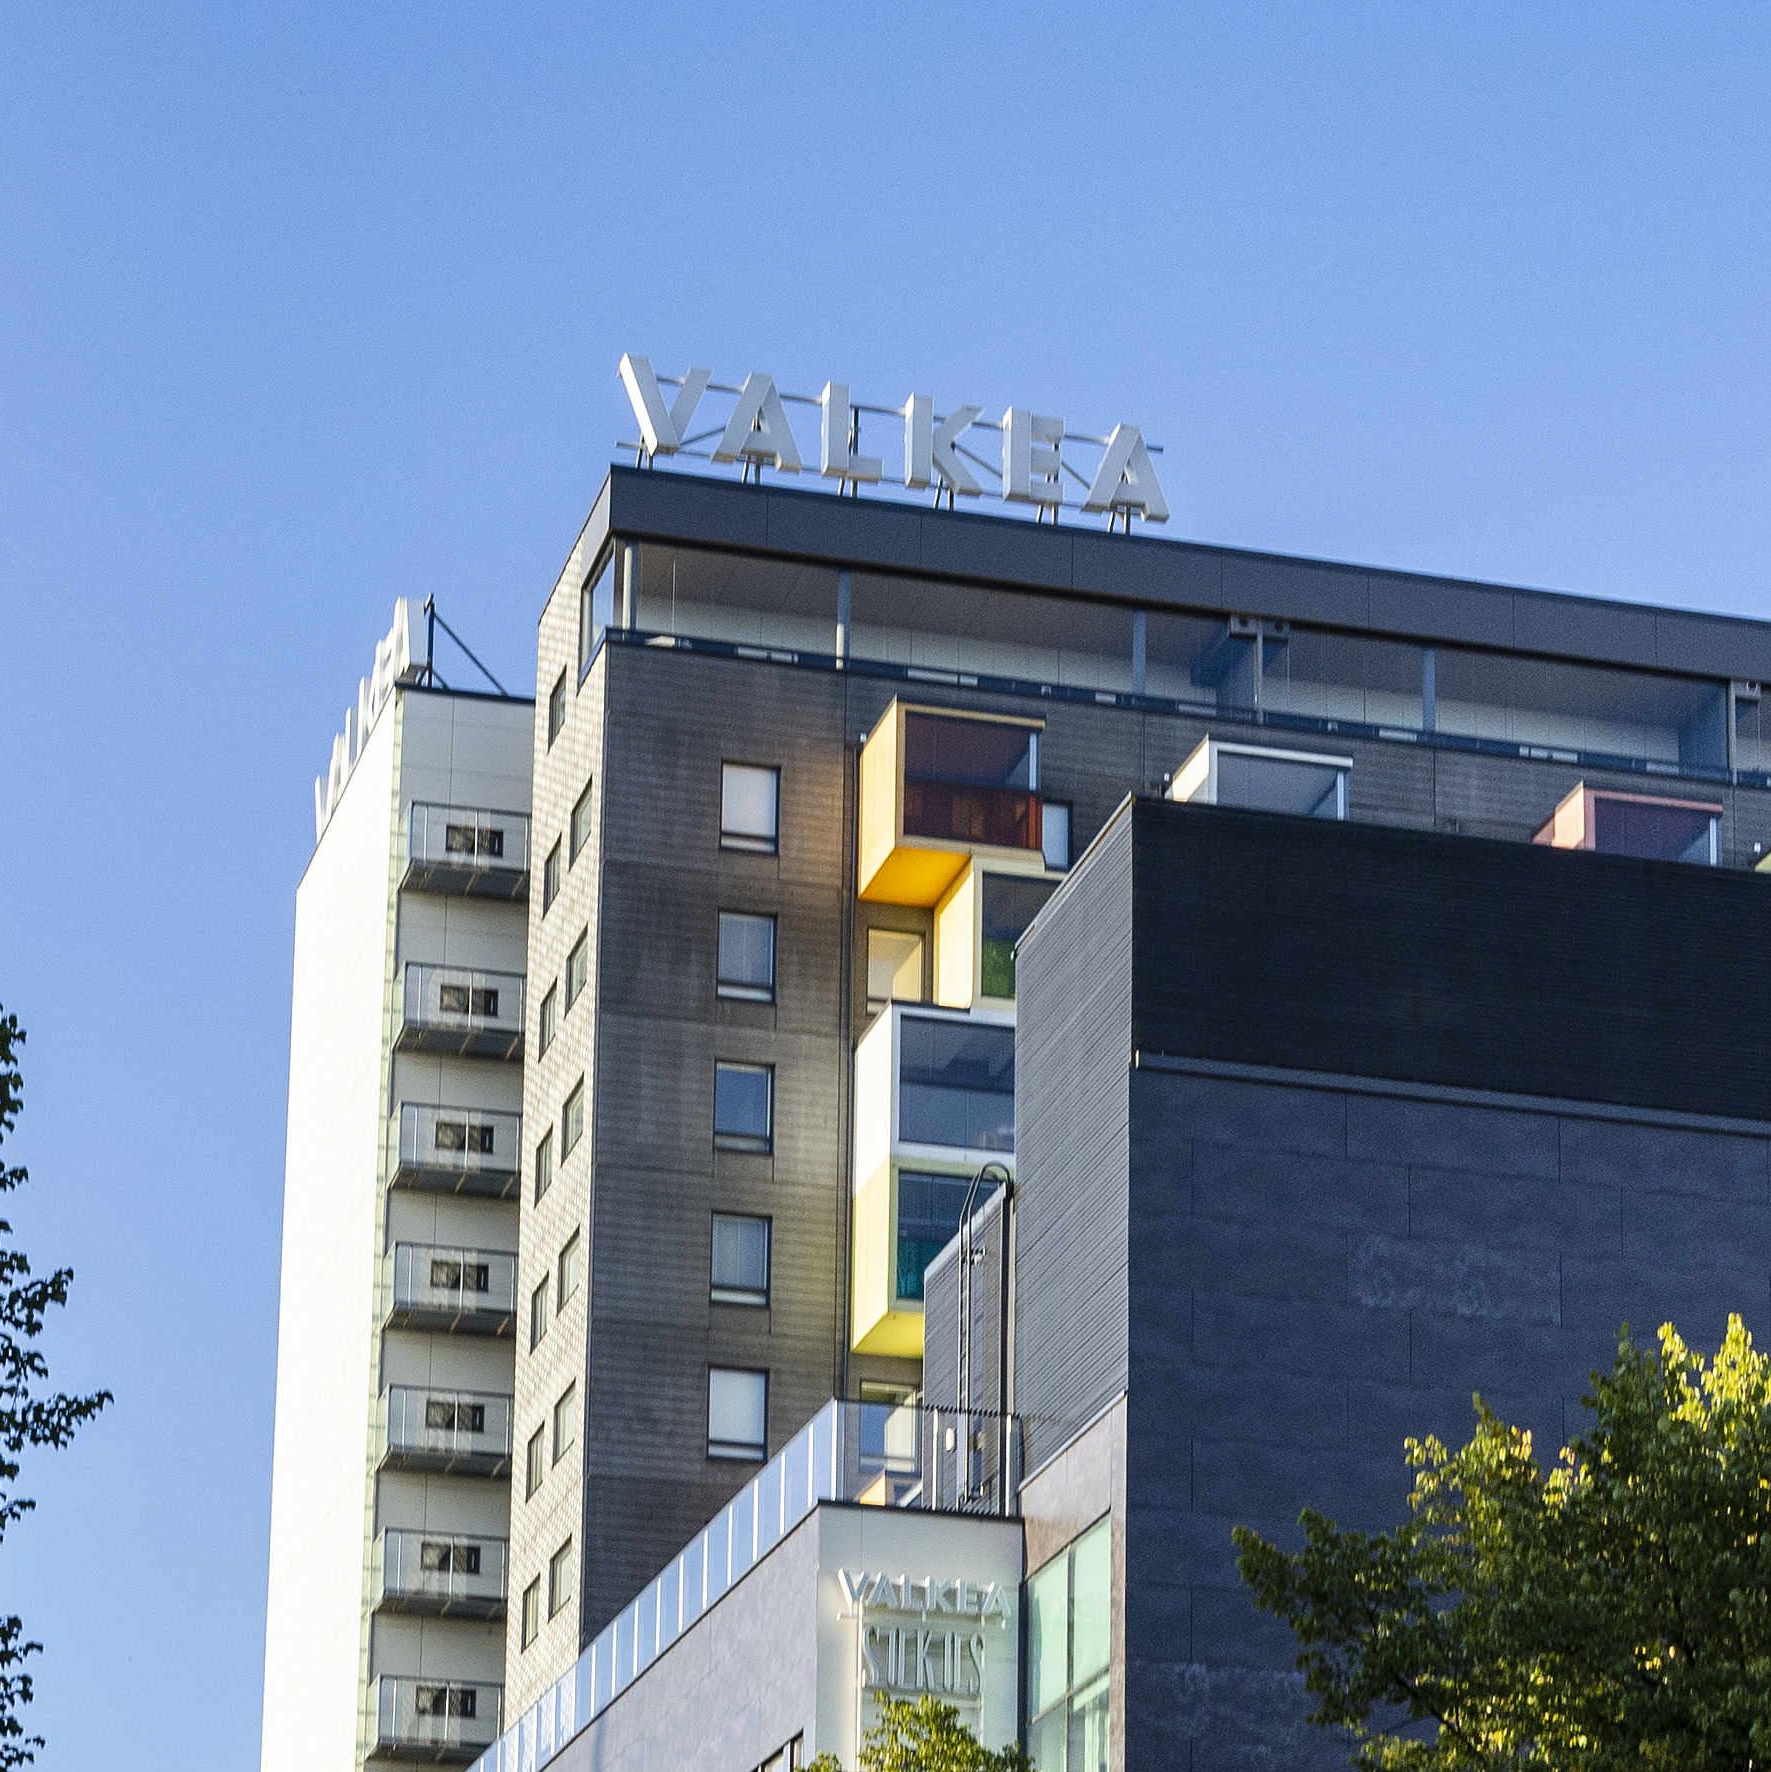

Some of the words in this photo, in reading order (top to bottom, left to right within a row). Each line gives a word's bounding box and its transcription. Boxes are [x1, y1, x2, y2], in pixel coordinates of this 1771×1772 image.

[618, 353, 1170, 523] VALKEA
[837, 1568, 1012, 1617] VALKEA
[863, 1625, 986, 1695] SOKOS
